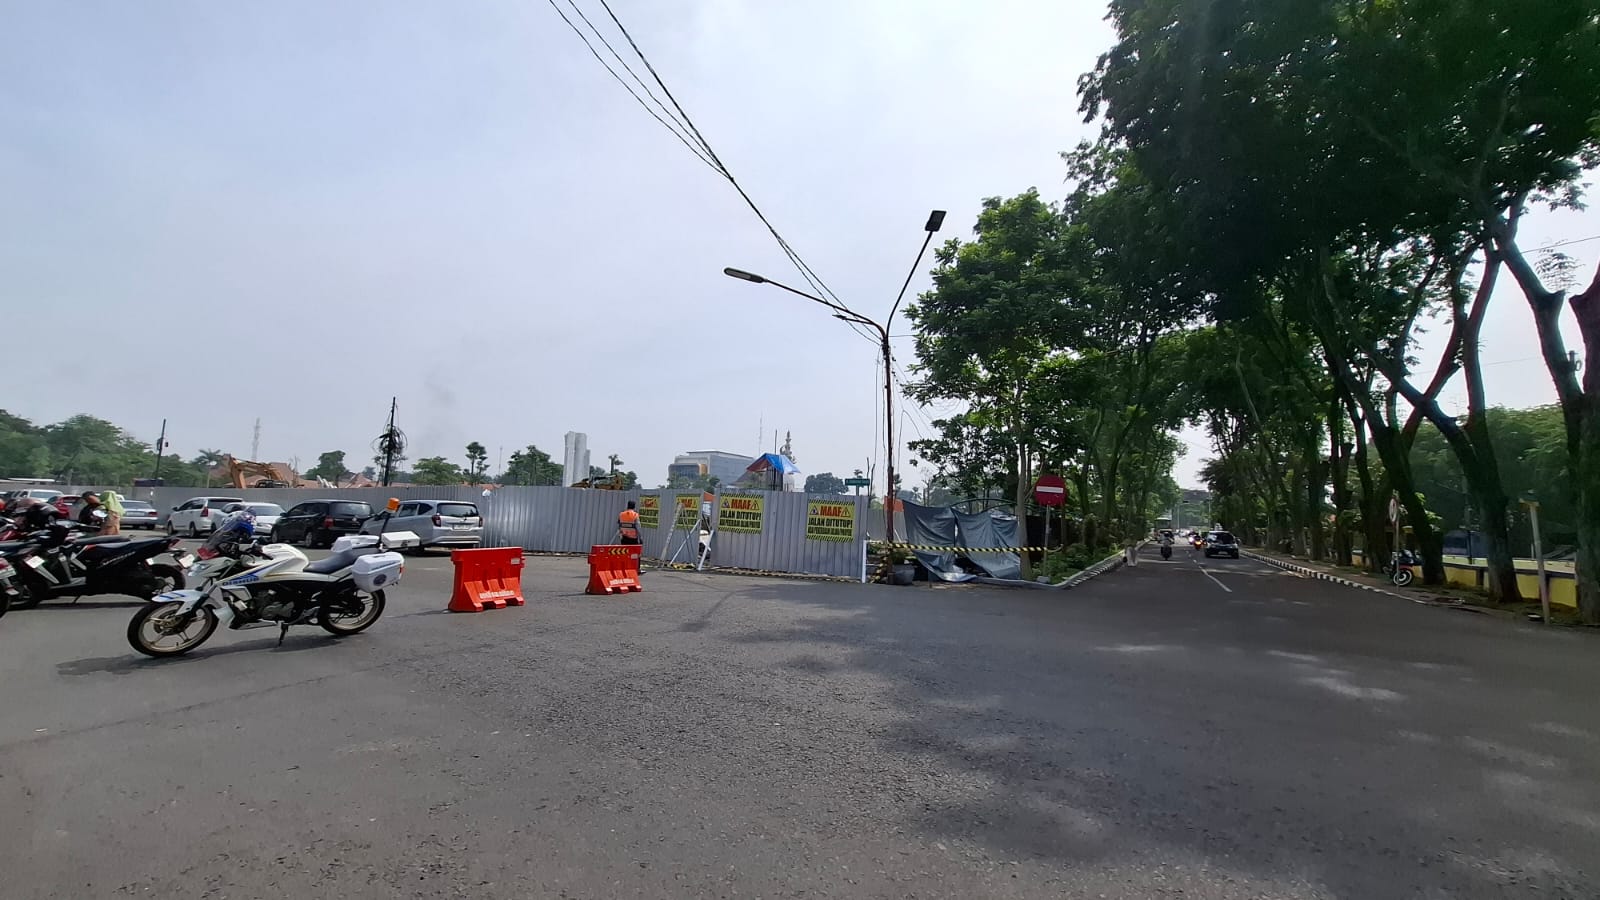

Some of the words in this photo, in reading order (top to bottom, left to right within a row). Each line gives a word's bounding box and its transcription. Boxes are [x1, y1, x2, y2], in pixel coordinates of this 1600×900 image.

[731, 499, 752, 510] MAAF
[719, 509, 736, 518] JALAN
[736, 511, 762, 521] DITUTUP!
[820, 505, 842, 517] MAAF
[807, 517, 825, 526] JALAN
[825, 518, 853, 529] DITUTUP!
